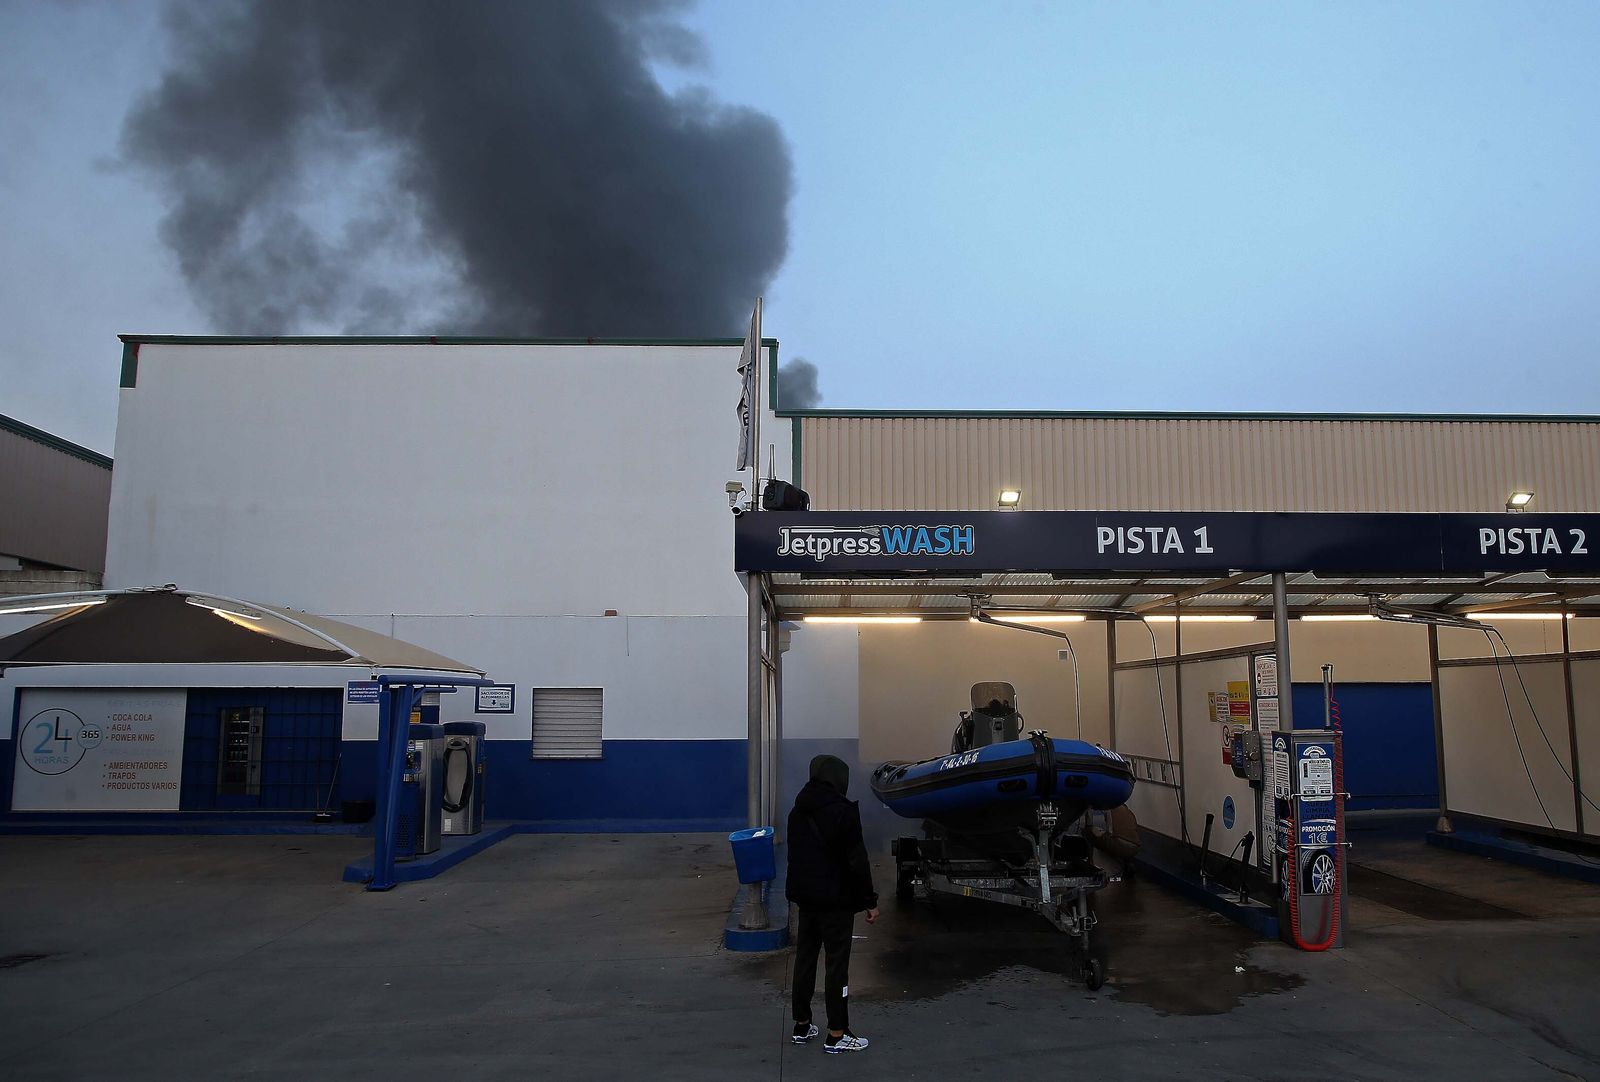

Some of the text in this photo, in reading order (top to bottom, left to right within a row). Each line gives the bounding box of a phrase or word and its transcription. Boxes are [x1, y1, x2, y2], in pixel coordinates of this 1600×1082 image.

[1097, 526, 1214, 554] PISTA 1
[1479, 528, 1588, 554] PISTA 2
[112, 713, 153, 721] COCA COLA
[81, 730, 100, 738] 365
[111, 734, 155, 742] POWER KING
[34, 756, 70, 764] HORAS
[109, 762, 168, 770] AMBIENTADORES
[107, 782, 177, 790] PRODUCTOS VARIOS
